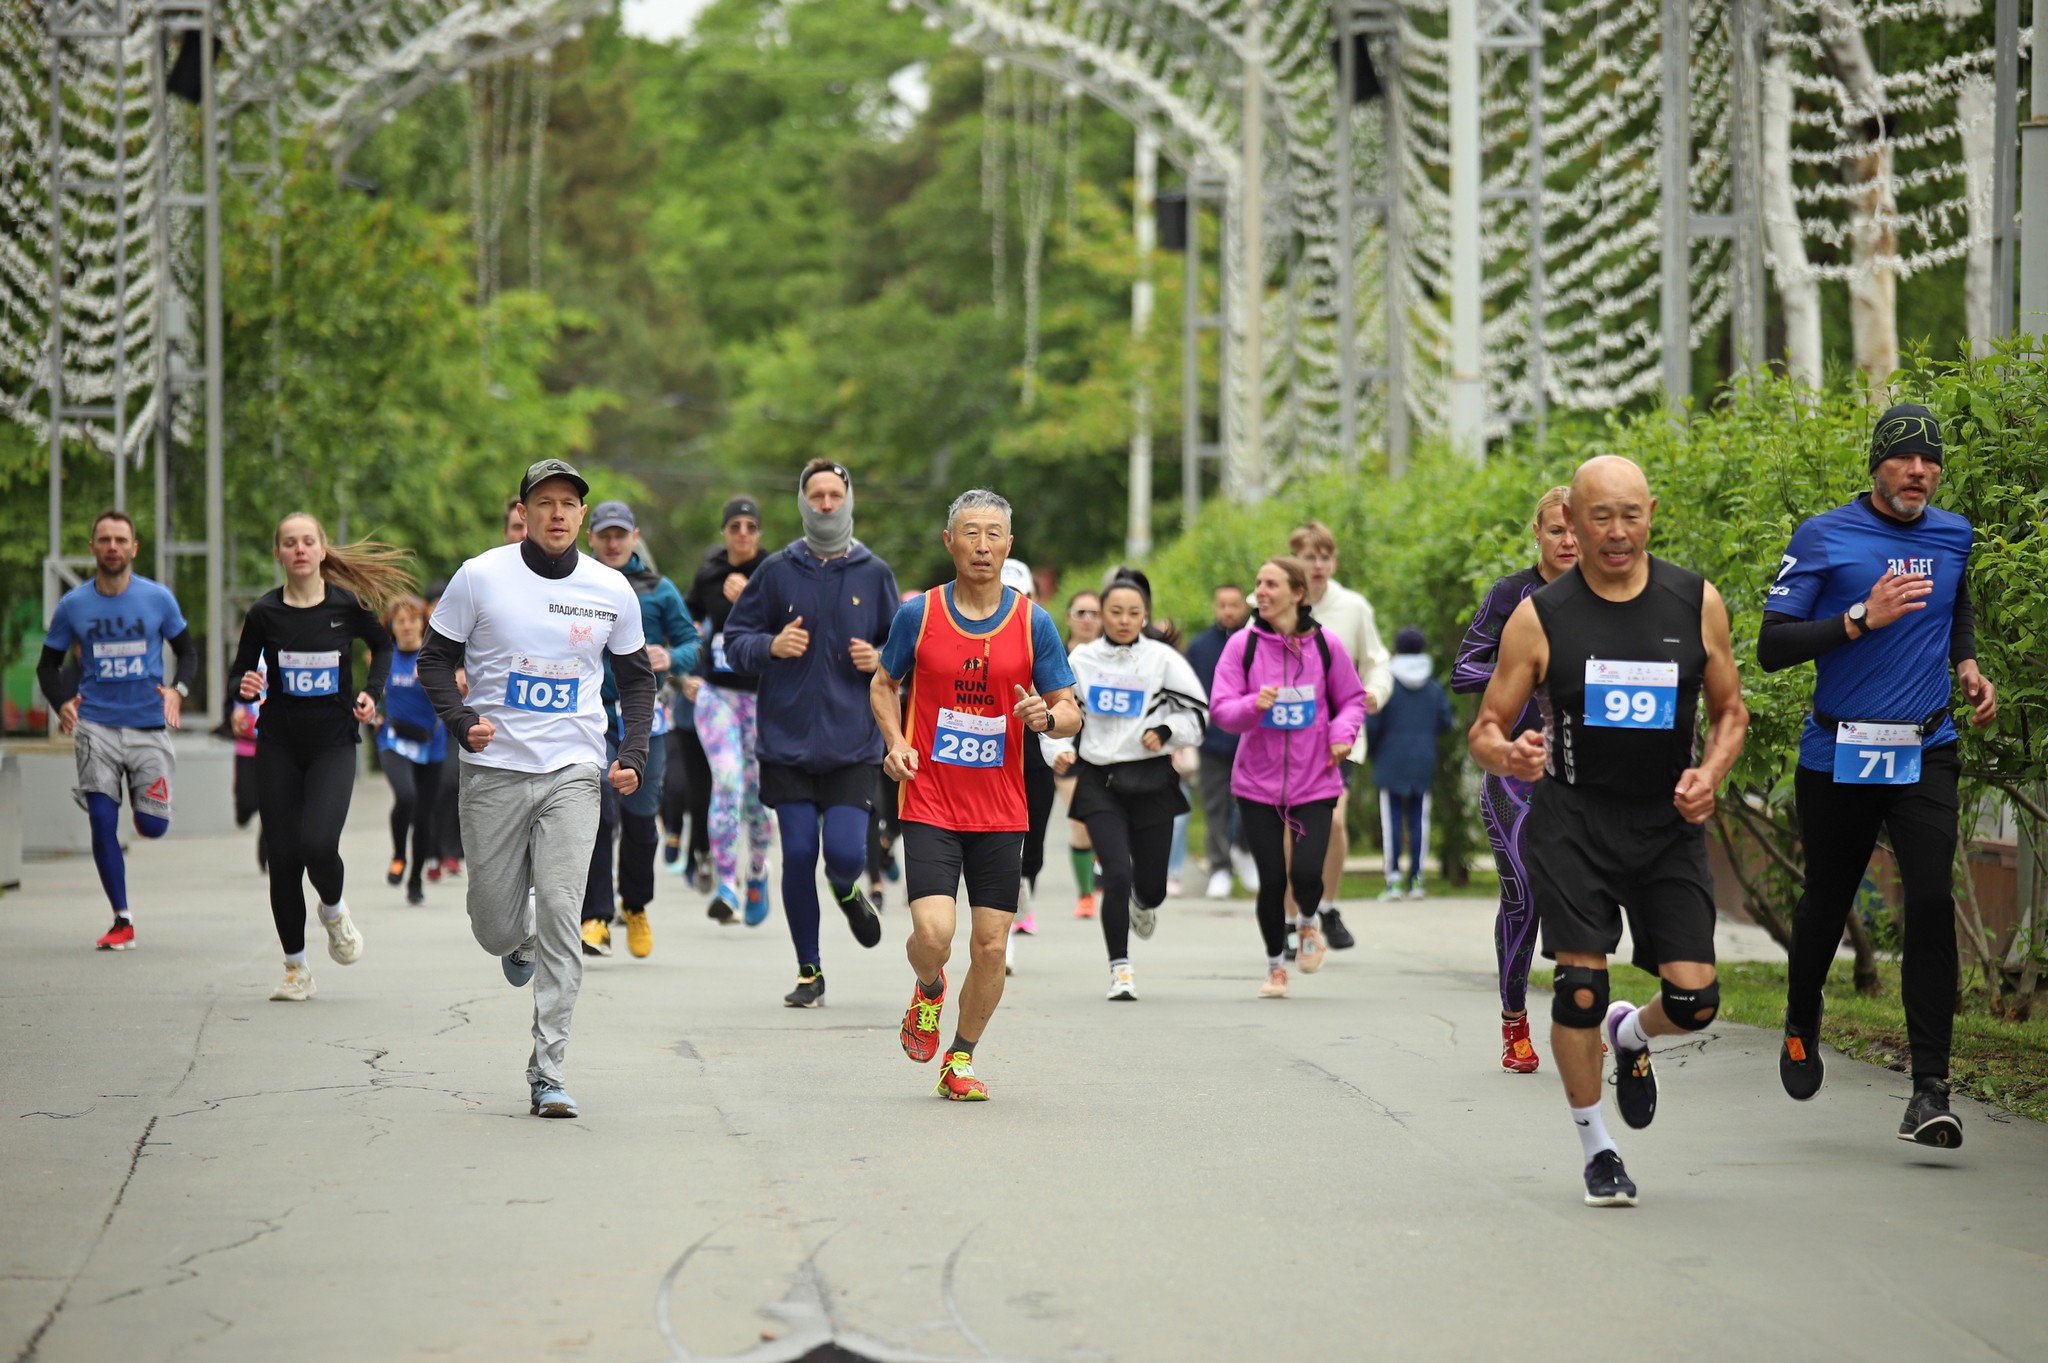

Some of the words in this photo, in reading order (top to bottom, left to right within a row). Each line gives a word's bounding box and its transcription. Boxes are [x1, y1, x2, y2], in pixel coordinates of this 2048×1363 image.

[549, 603, 593, 618] ВЛАДИСЛАВ
[100, 657, 144, 678] 254
[285, 670, 331, 692] 164
[954, 679, 987, 692] RUN
[516, 680, 571, 709] 103
[956, 693, 995, 705] NING
[1098, 689, 1130, 713] 85
[1272, 704, 1305, 726] 83
[1604, 690, 1657, 722] 99
[938, 734, 998, 763] 288
[1858, 750, 1896, 778] 71
